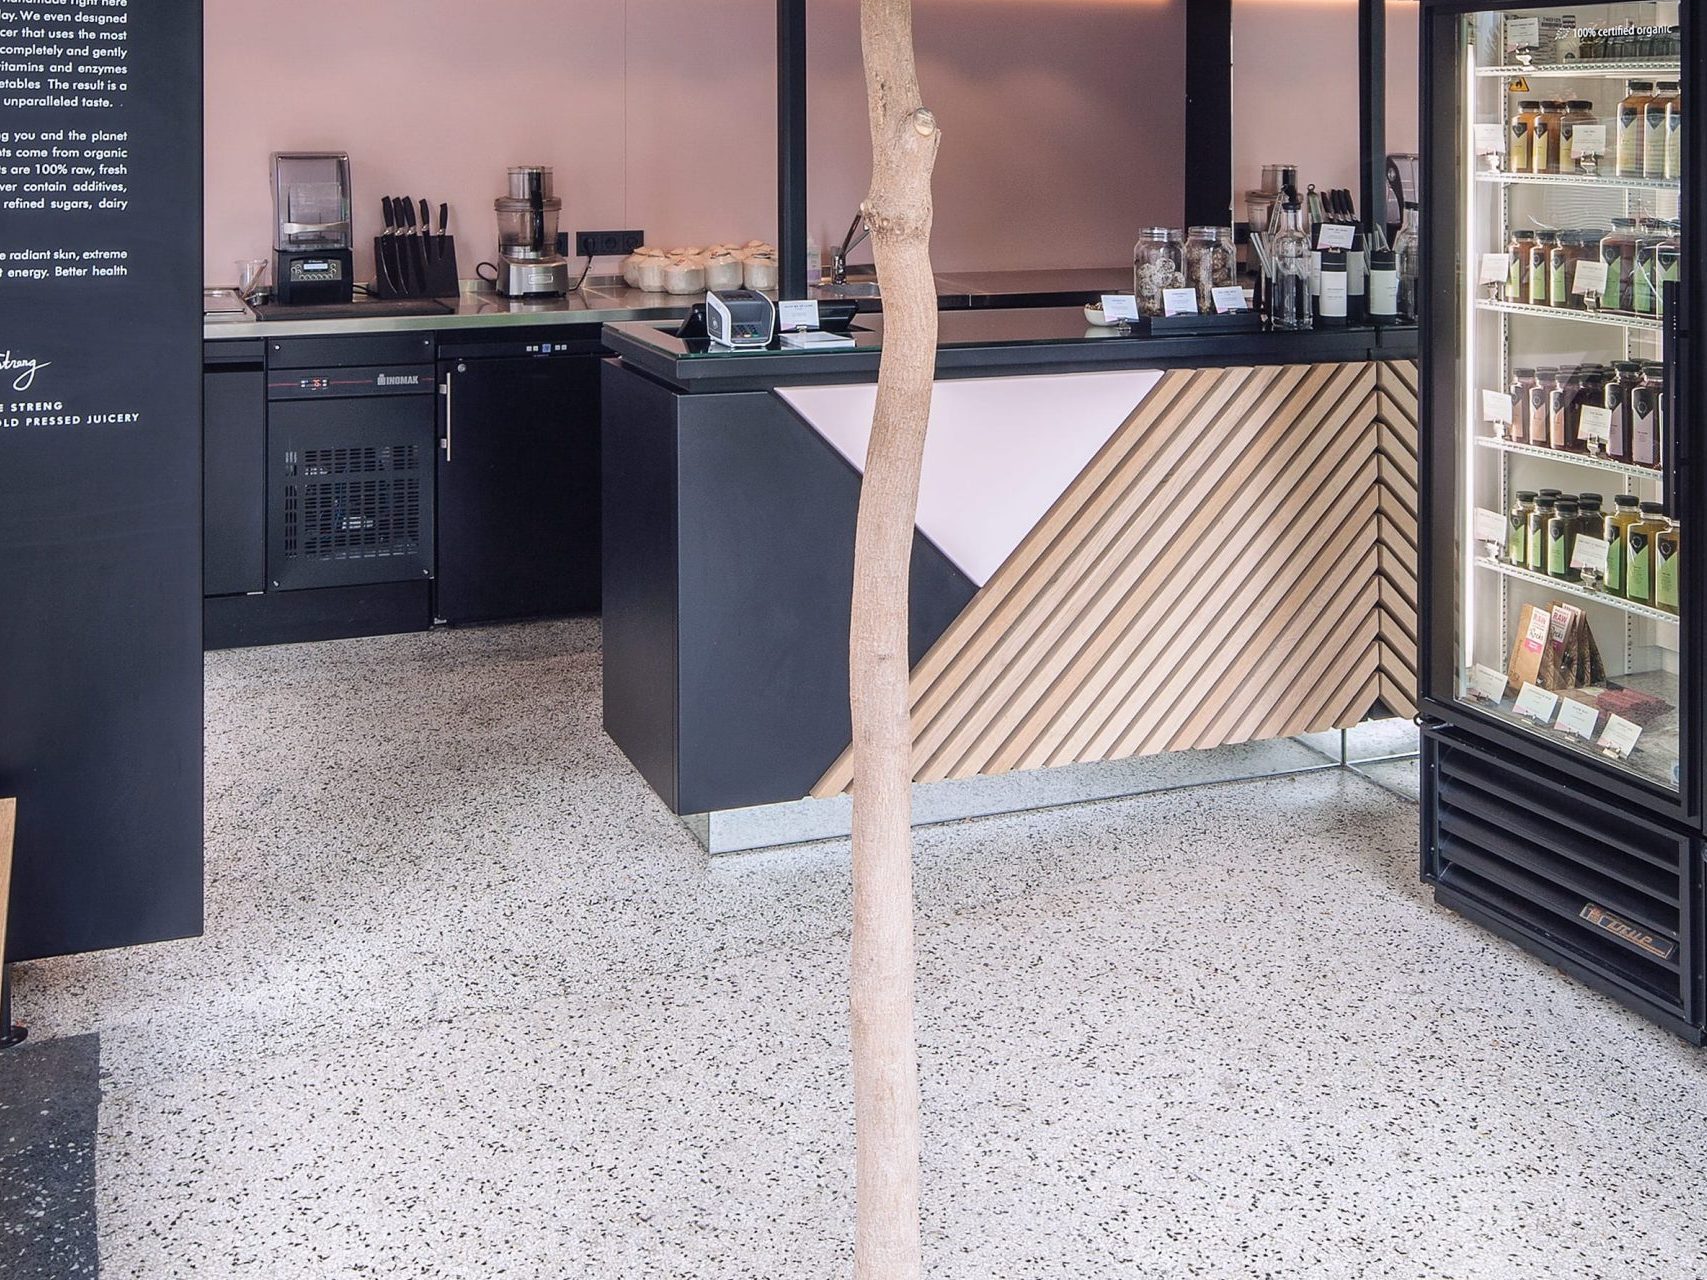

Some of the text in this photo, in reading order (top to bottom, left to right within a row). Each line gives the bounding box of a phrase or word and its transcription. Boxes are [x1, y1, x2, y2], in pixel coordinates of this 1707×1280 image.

[20, 11, 40, 20] We
[75, 12, 127, 25] designed
[22, 27, 45, 37] that
[78, 29, 96, 39] the
[100, 31, 127, 40] most
[1573, 24, 1673, 38] 100% certified organic
[0, 44, 127, 59] completely and gently
[50, 62, 72, 72] and
[78, 65, 127, 75] enzymes
[48, 79, 69, 89] The
[73, 80, 104, 90] result
[108, 80, 116, 90] is
[4, 96, 113, 108] unparalleled taste.
[14, 133, 35, 142] you
[41, 130, 63, 140] and
[68, 130, 86, 140] the
[92, 130, 127, 143] planet
[52, 147, 79, 157] from
[84, 148, 127, 159] organic
[35, 164, 67, 174] 100%
[72, 167, 95, 176] raw,
[99, 164, 127, 174] fresh
[24, 182, 66, 191] contain
[73, 181, 127, 192] additives,
[4, 198, 128, 210] refined sugars, dairy
[10, 249, 51, 260] radiant
[54, 249, 79, 260] skin,
[83, 250, 127, 259] extreme
[8, 269, 49, 279] energy.
[55, 266, 88, 276] Better
[92, 265, 127, 275] health
[11, 402, 62, 412] STRENG
[0, 413, 139, 427] LD PRESSED JUICERY
